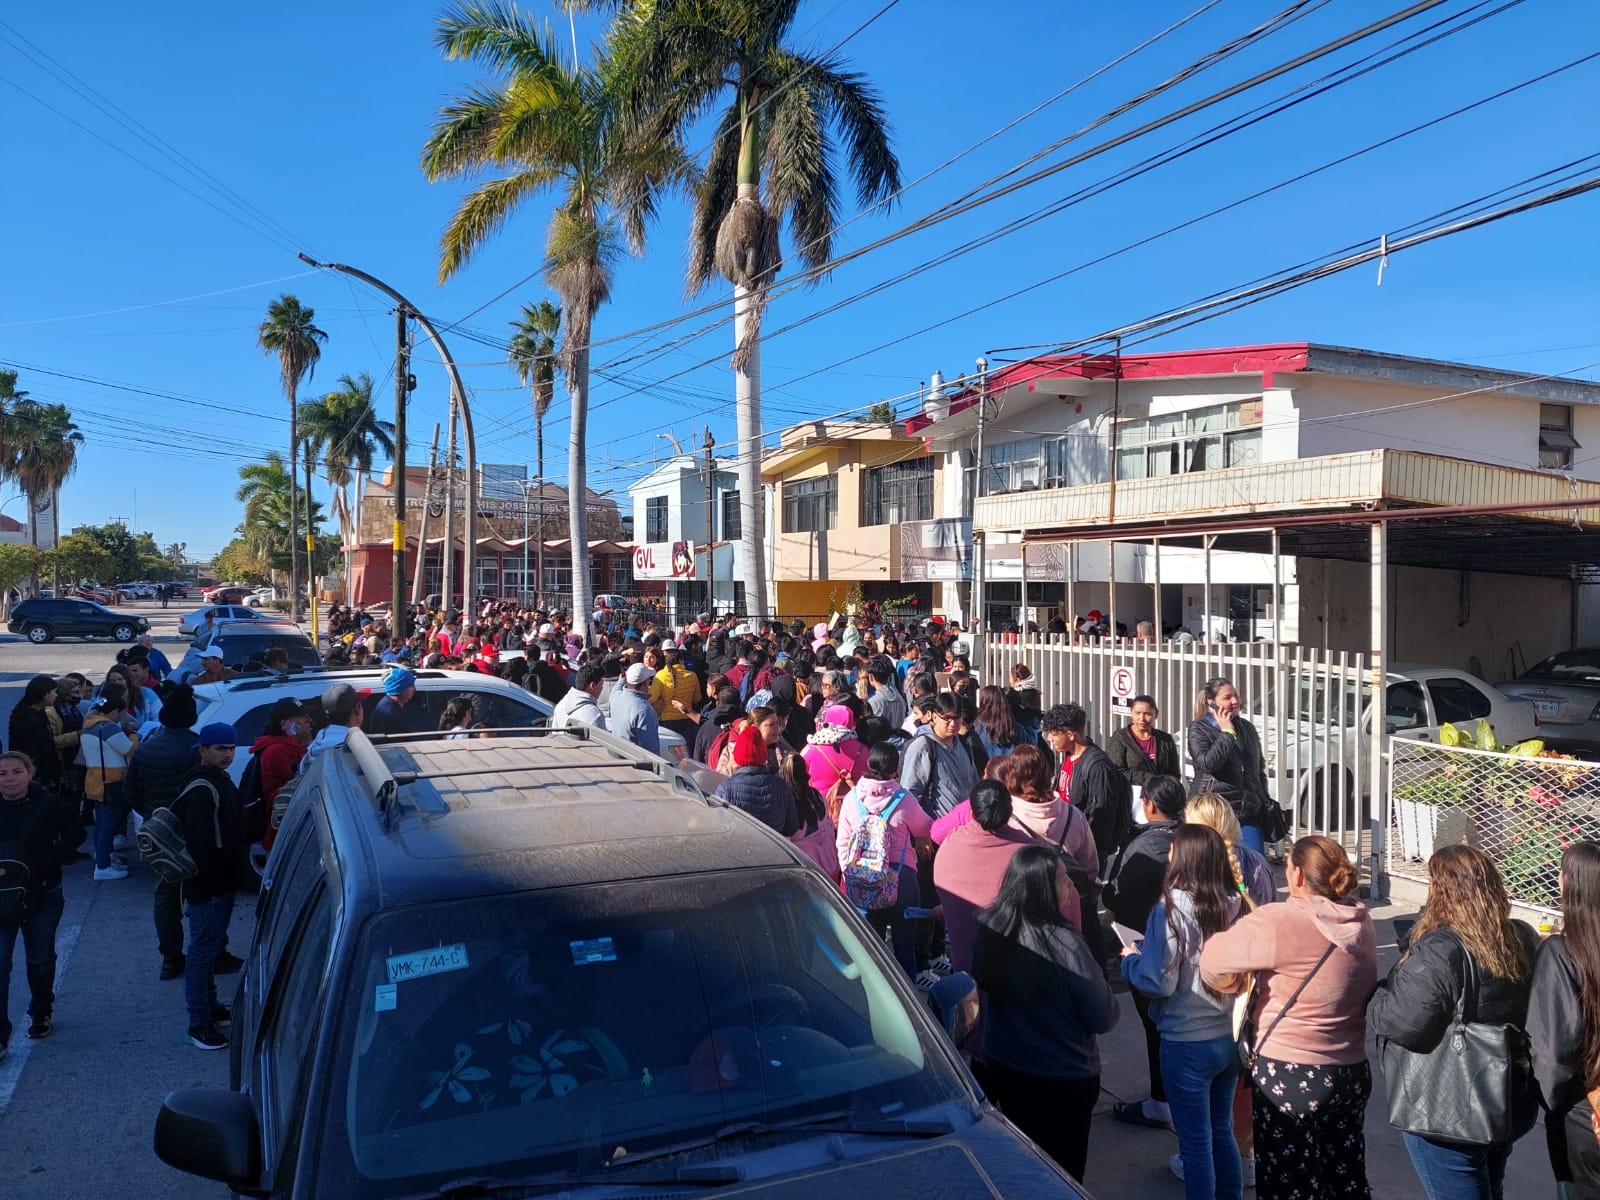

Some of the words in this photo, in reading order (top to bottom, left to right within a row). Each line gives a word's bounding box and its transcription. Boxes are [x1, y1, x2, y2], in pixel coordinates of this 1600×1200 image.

[383, 497, 428, 507] TETRO
[636, 547, 656, 570] GVL
[391, 951, 460, 977] VMK-744-C
